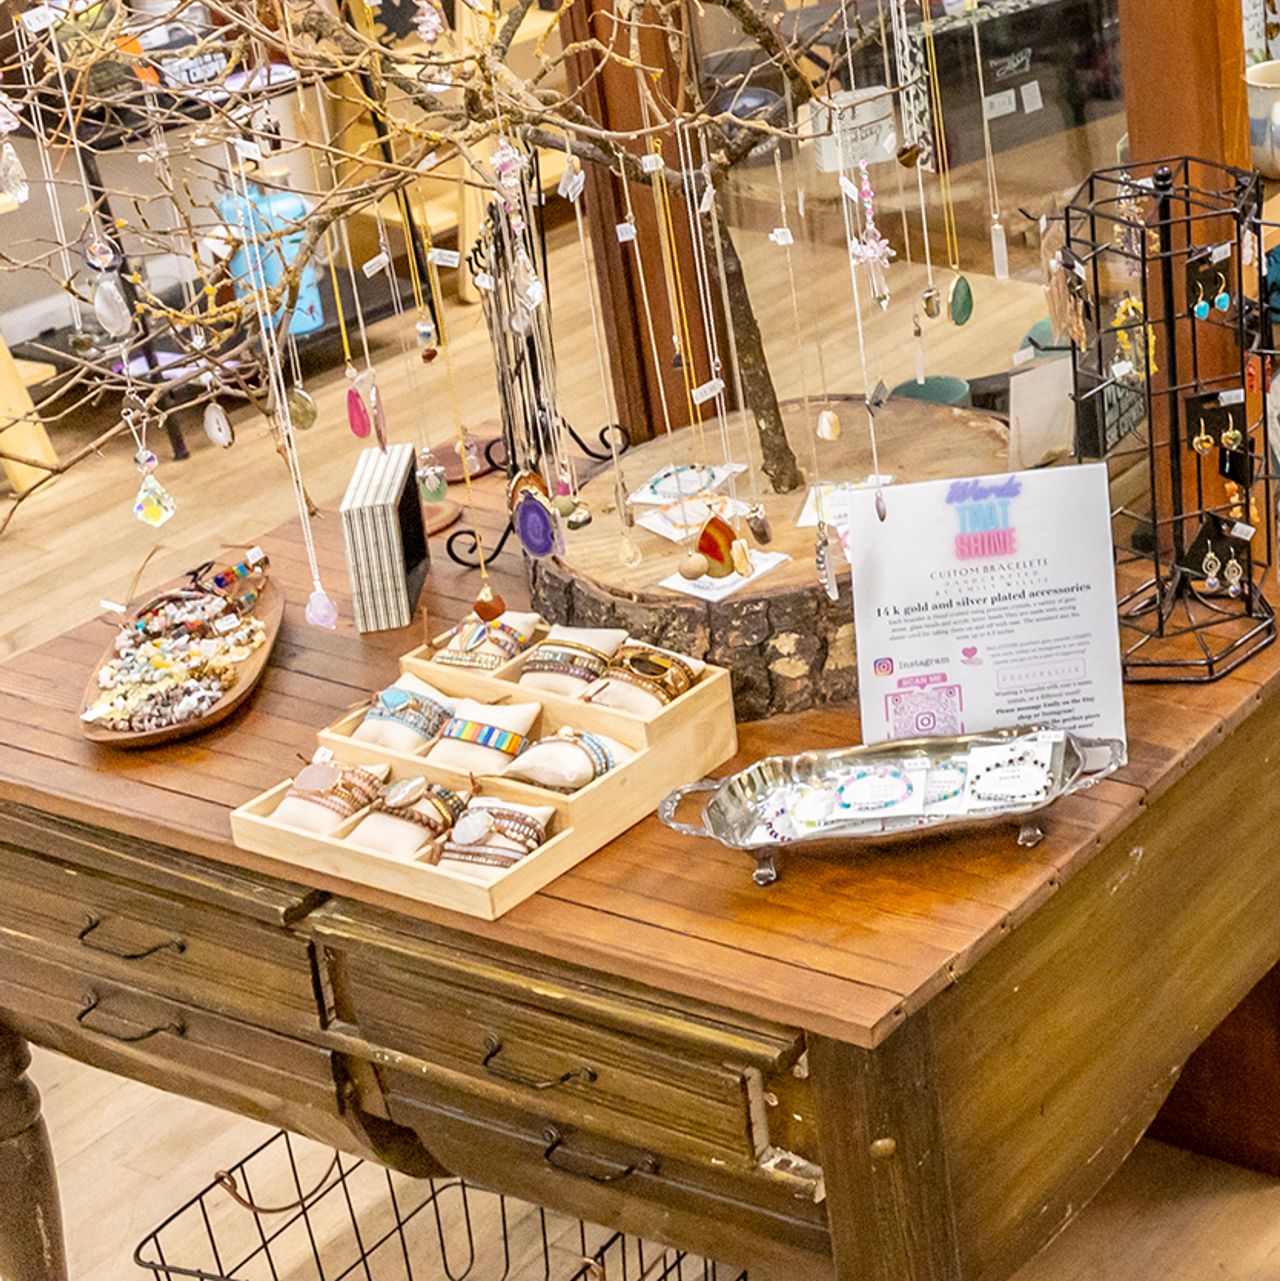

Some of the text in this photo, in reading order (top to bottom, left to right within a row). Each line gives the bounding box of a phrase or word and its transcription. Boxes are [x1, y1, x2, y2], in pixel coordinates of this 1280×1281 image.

[945, 476, 1022, 504] Words
[956, 499, 1011, 532] THAT
[957, 530, 1016, 558] SHINE
[930, 557, 1048, 580] CUSTOM BRACELETS
[903, 602, 929, 616] gold
[931, 599, 953, 611] and
[955, 595, 988, 609] silver
[990, 590, 1026, 605] plated
[1028, 581, 1092, 599] accessories
[899, 656, 950, 670] Instagram
[901, 673, 943, 686] SCAN ME
